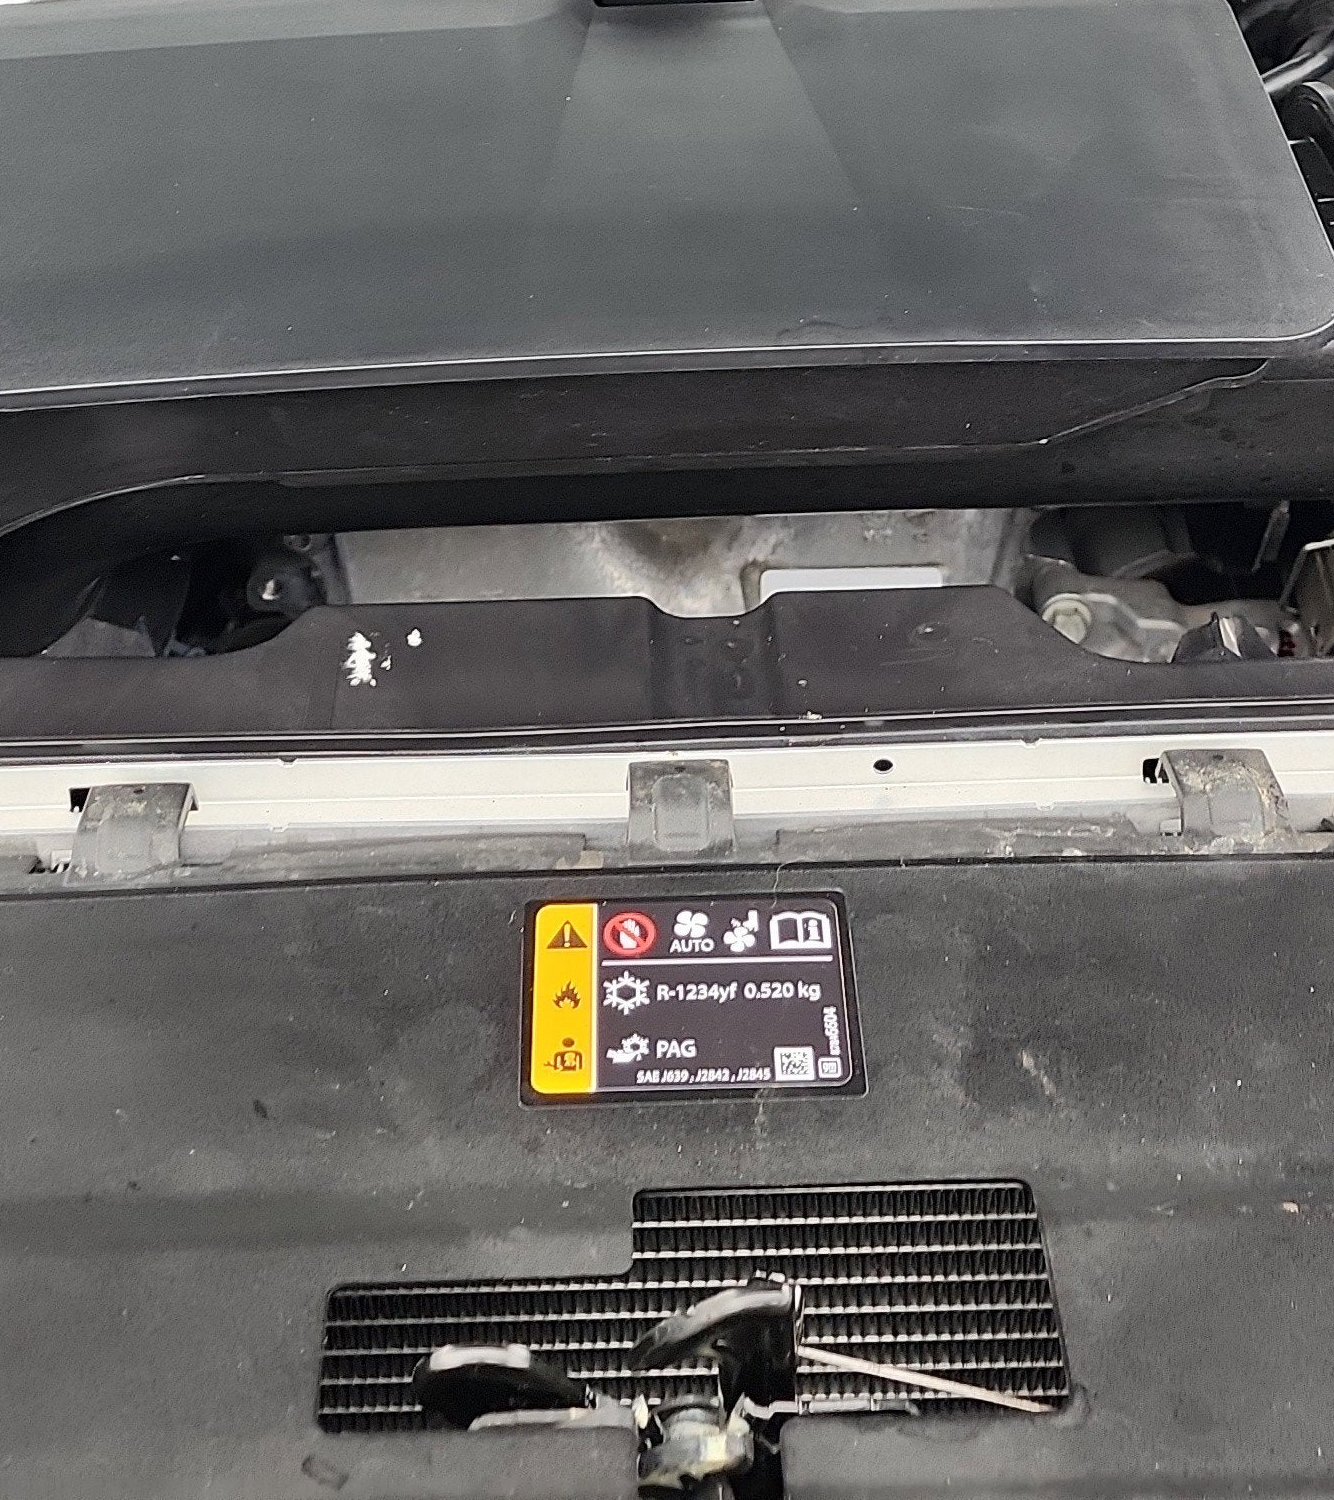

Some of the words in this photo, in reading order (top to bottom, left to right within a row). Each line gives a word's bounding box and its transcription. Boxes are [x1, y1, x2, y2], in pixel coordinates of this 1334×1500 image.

[669, 937, 716, 954] AUTO
[656, 980, 738, 1004] R-1234yf
[797, 979, 822, 1002] kg
[655, 1037, 698, 1060] PAG
[636, 1068, 661, 1084] SAE
